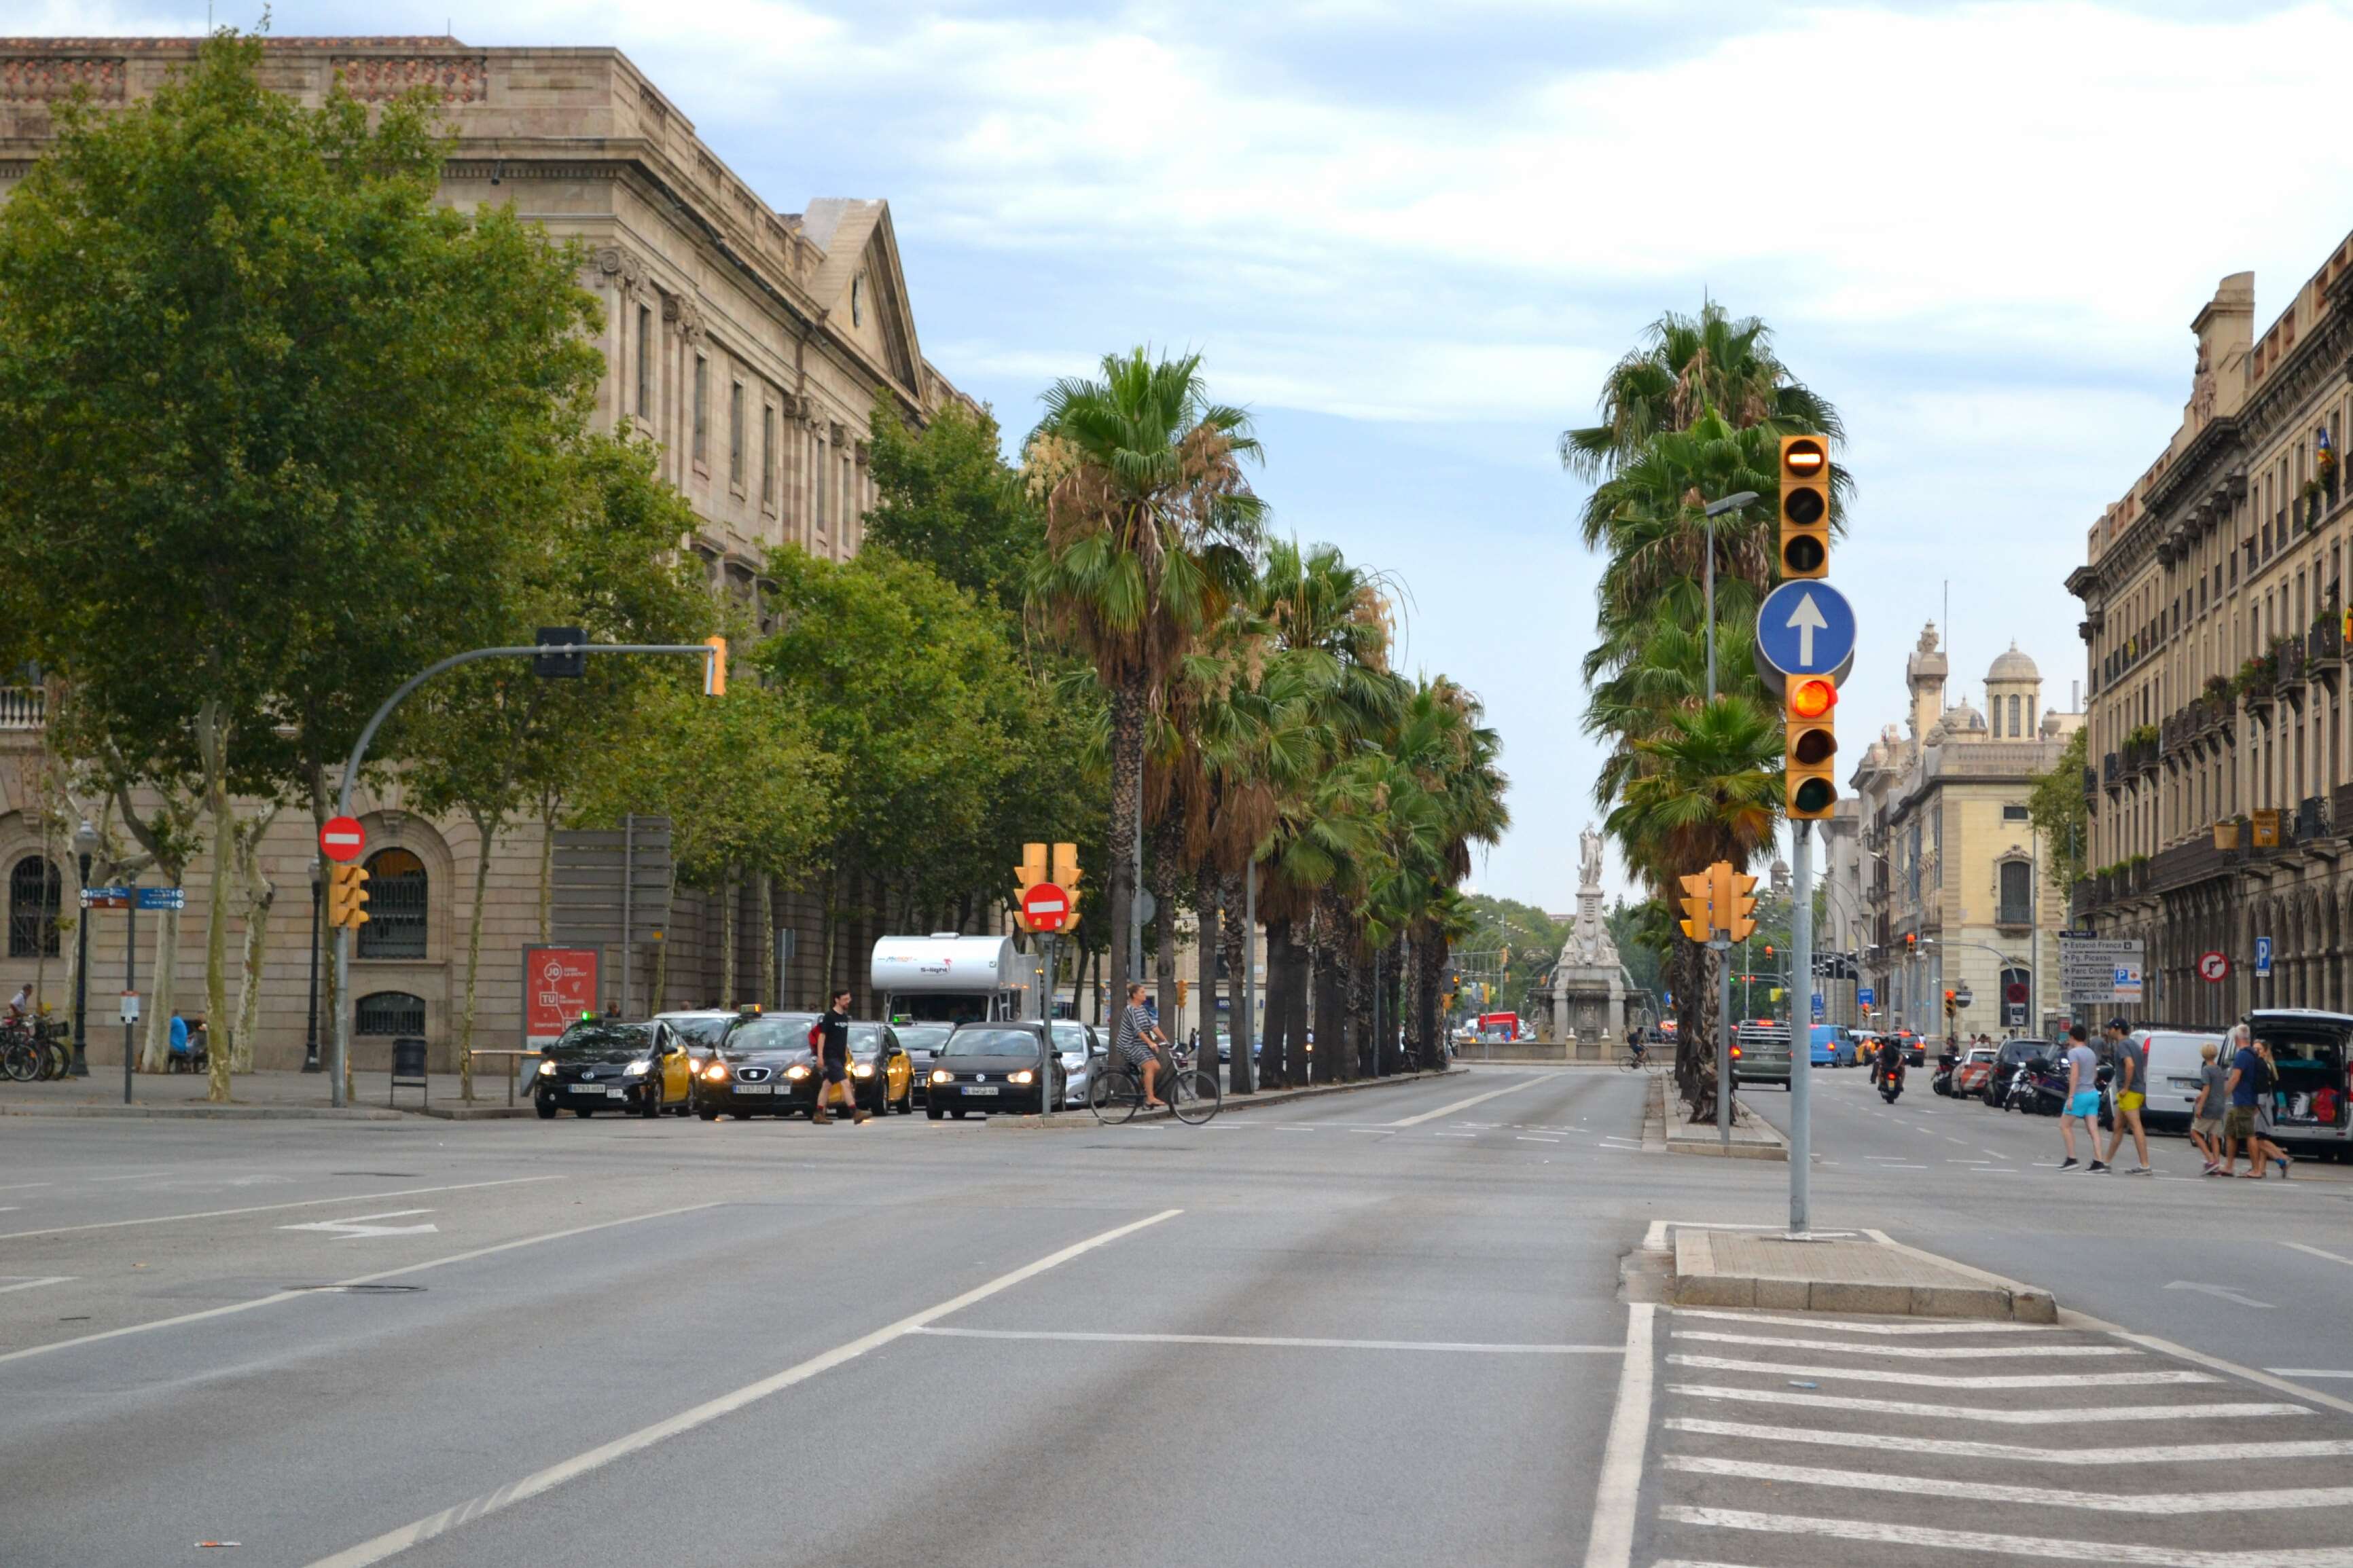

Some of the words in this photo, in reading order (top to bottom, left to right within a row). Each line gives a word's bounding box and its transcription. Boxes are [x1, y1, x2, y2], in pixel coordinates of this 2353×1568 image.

[2259, 941, 2267, 966] P
[547, 967, 559, 977] JO
[2119, 970, 2125, 979] P
[542, 995, 555, 1003] TU
